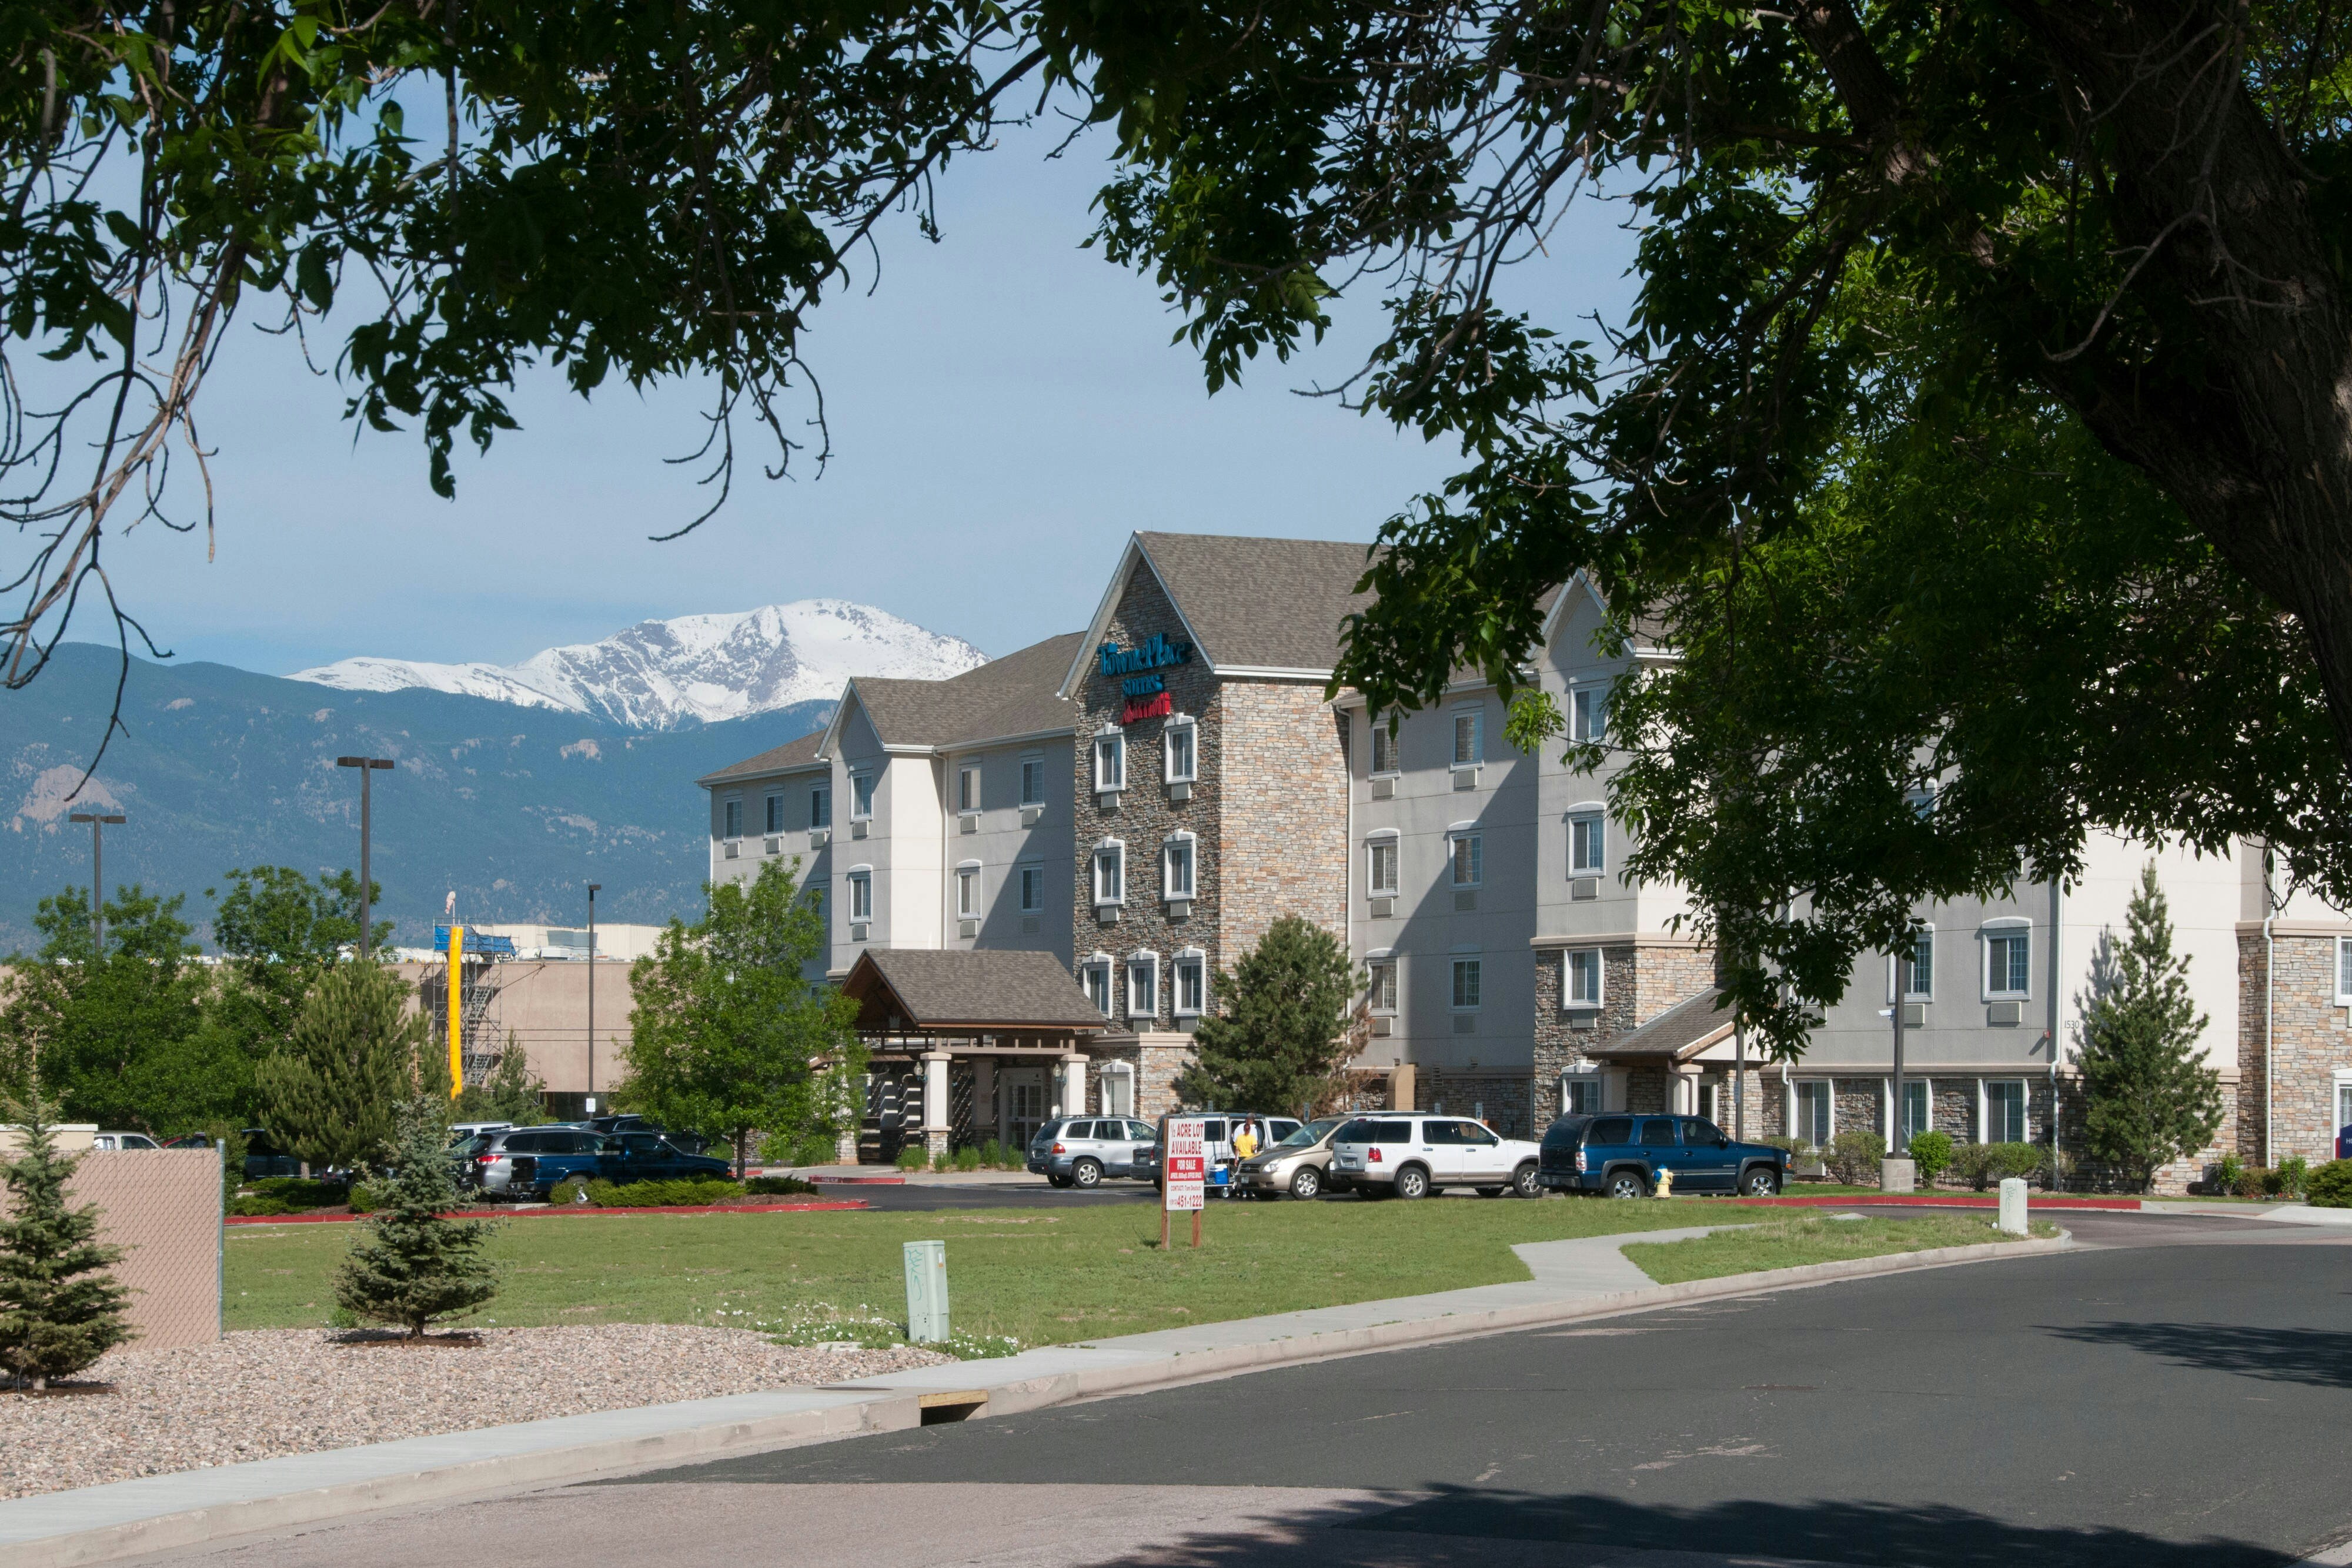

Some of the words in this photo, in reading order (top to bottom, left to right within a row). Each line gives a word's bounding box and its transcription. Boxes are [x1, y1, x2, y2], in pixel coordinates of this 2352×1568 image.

[2064, 1020, 2080, 1029] 1530
[1177, 1124, 1191, 1137] ACRE
[1193, 1124, 1204, 1138] LOT
[1171, 1141, 1202, 1155] AVAILABLE
[1177, 1159, 1185, 1170] FOR
[1185, 1159, 1196, 1170] SALE
